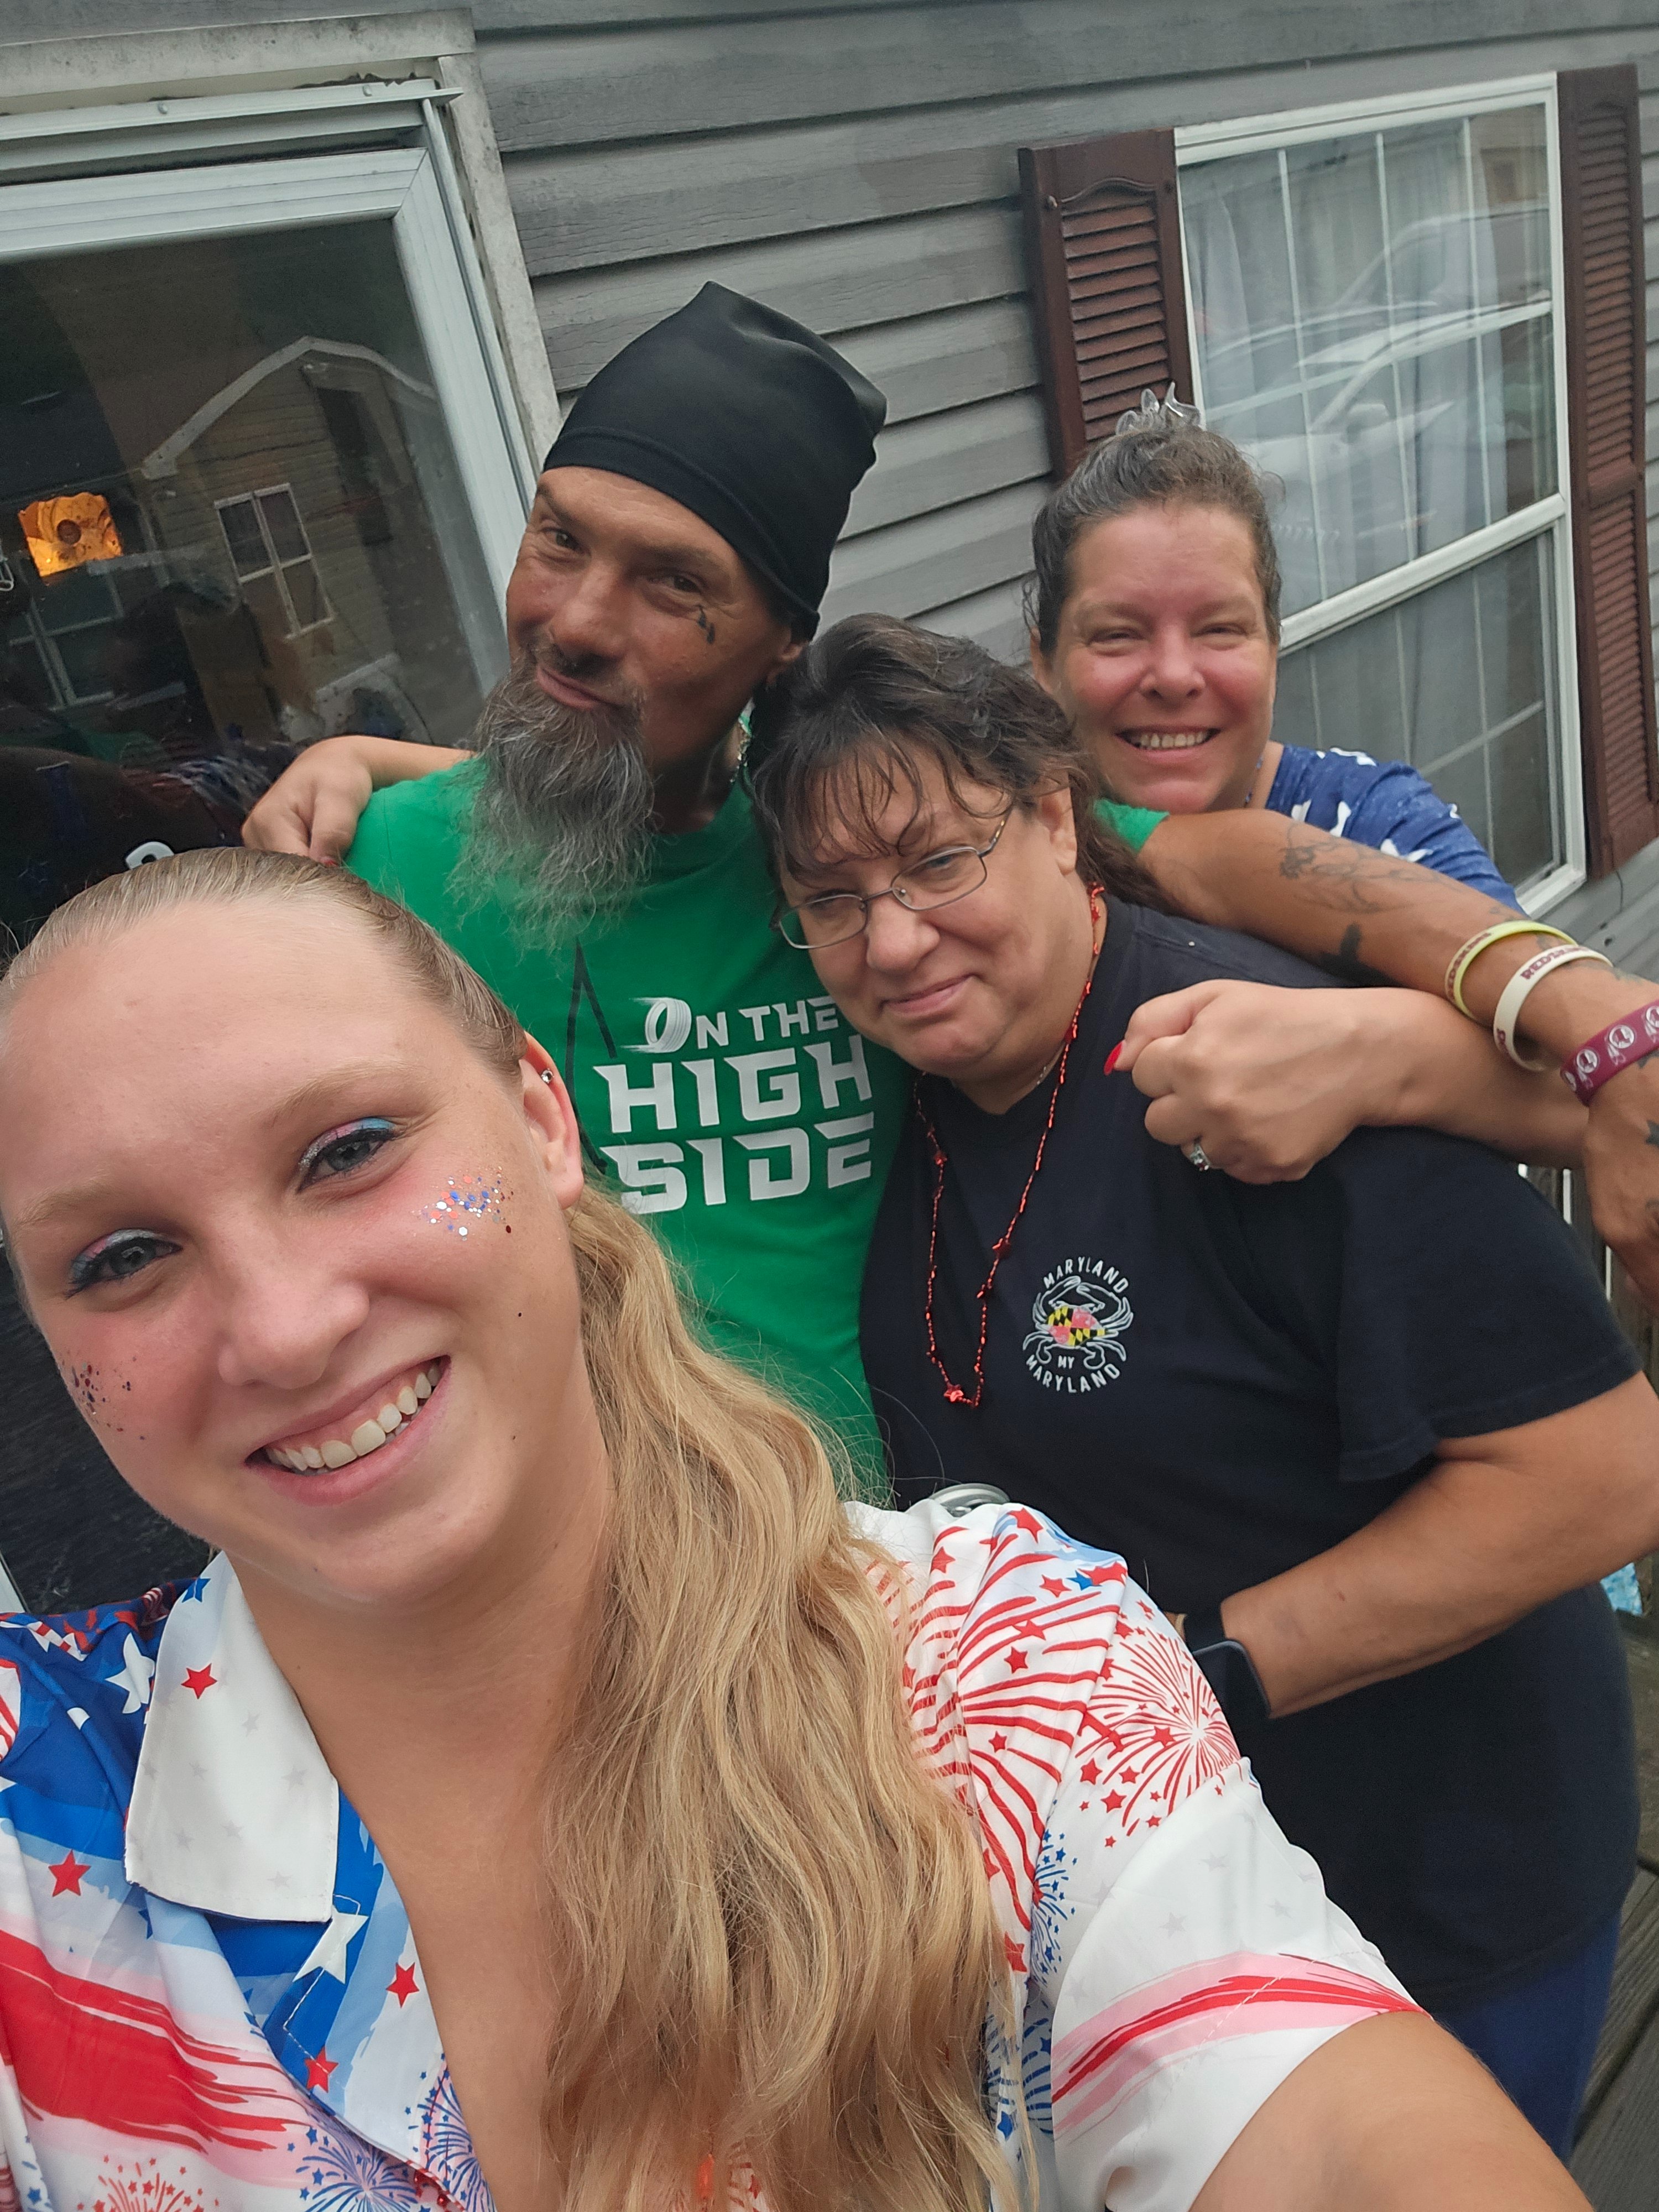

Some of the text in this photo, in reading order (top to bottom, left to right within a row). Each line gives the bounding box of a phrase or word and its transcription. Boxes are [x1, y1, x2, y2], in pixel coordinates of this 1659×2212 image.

[628, 995, 839, 1053] ON THE
[593, 1034, 873, 1134] HIGH
[599, 1112, 874, 1214] SIDE
[1043, 1256, 1129, 1293] MARYLAND
[1026, 1354, 1120, 1393] MARYLAND
[1057, 1355, 1076, 1370] MY
